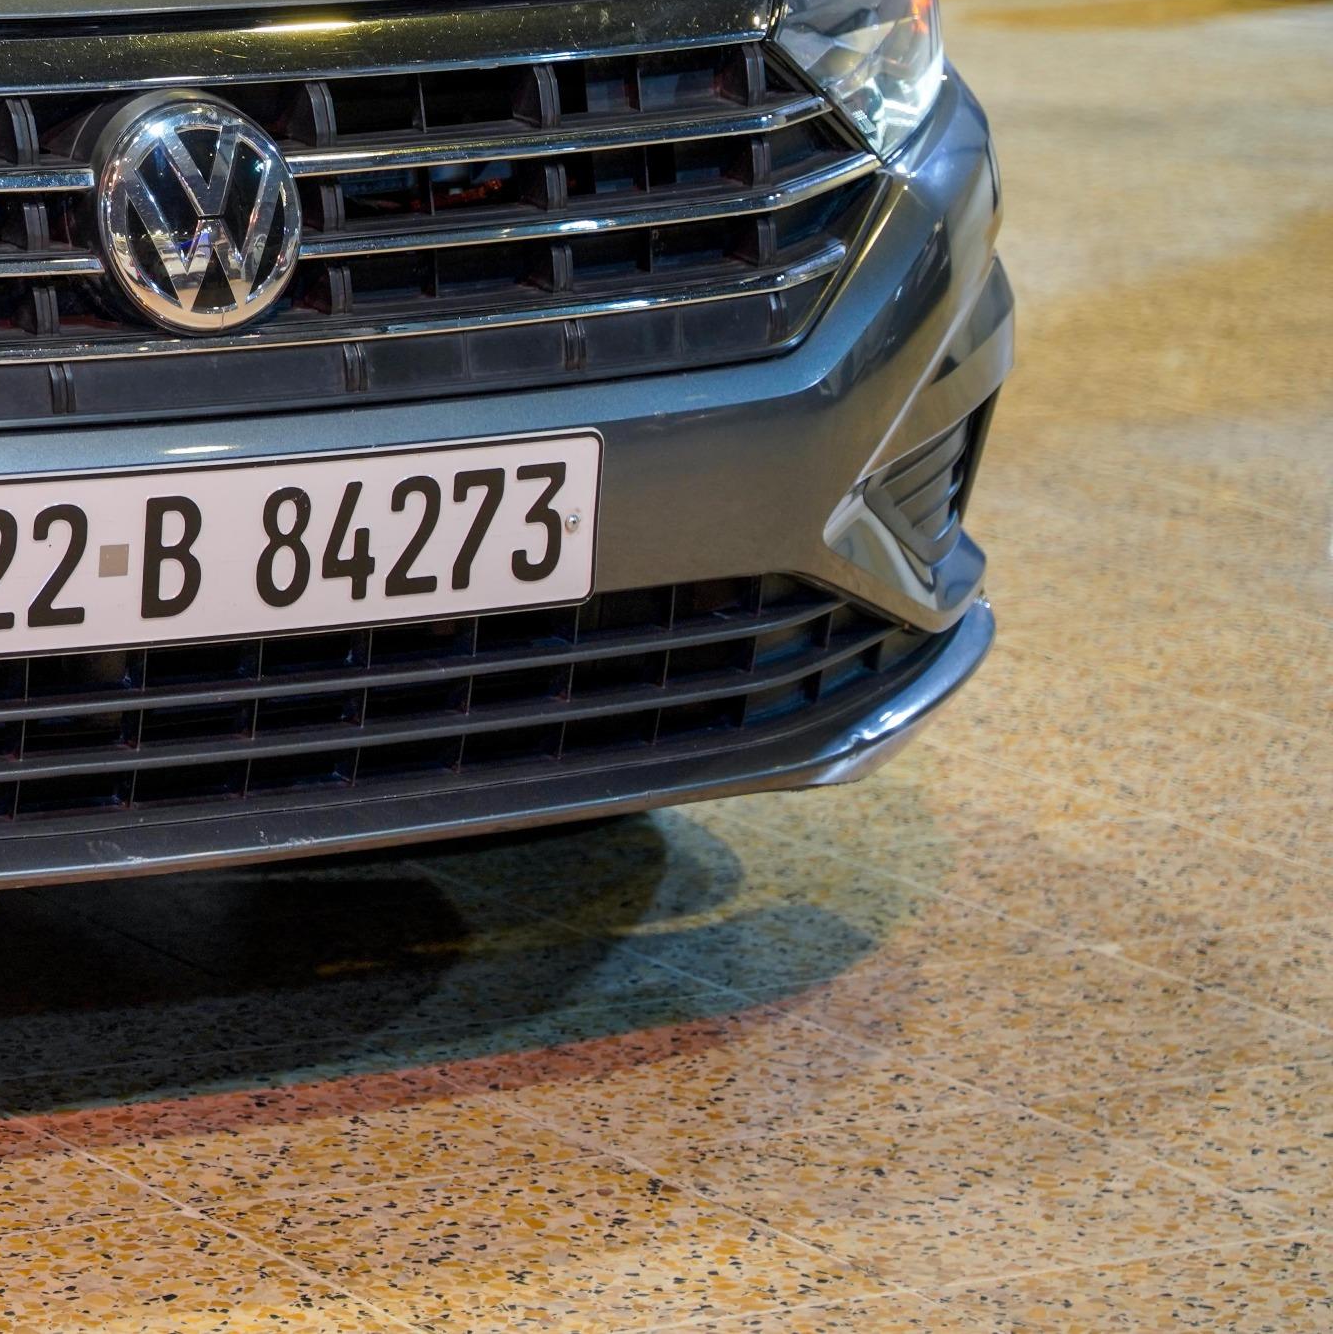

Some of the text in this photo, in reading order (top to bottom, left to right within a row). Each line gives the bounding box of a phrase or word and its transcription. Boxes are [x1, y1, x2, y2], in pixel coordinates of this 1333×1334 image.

[101, 104, 300, 332] VW
[140, 495, 202, 619] B
[255, 461, 567, 608] 84273
